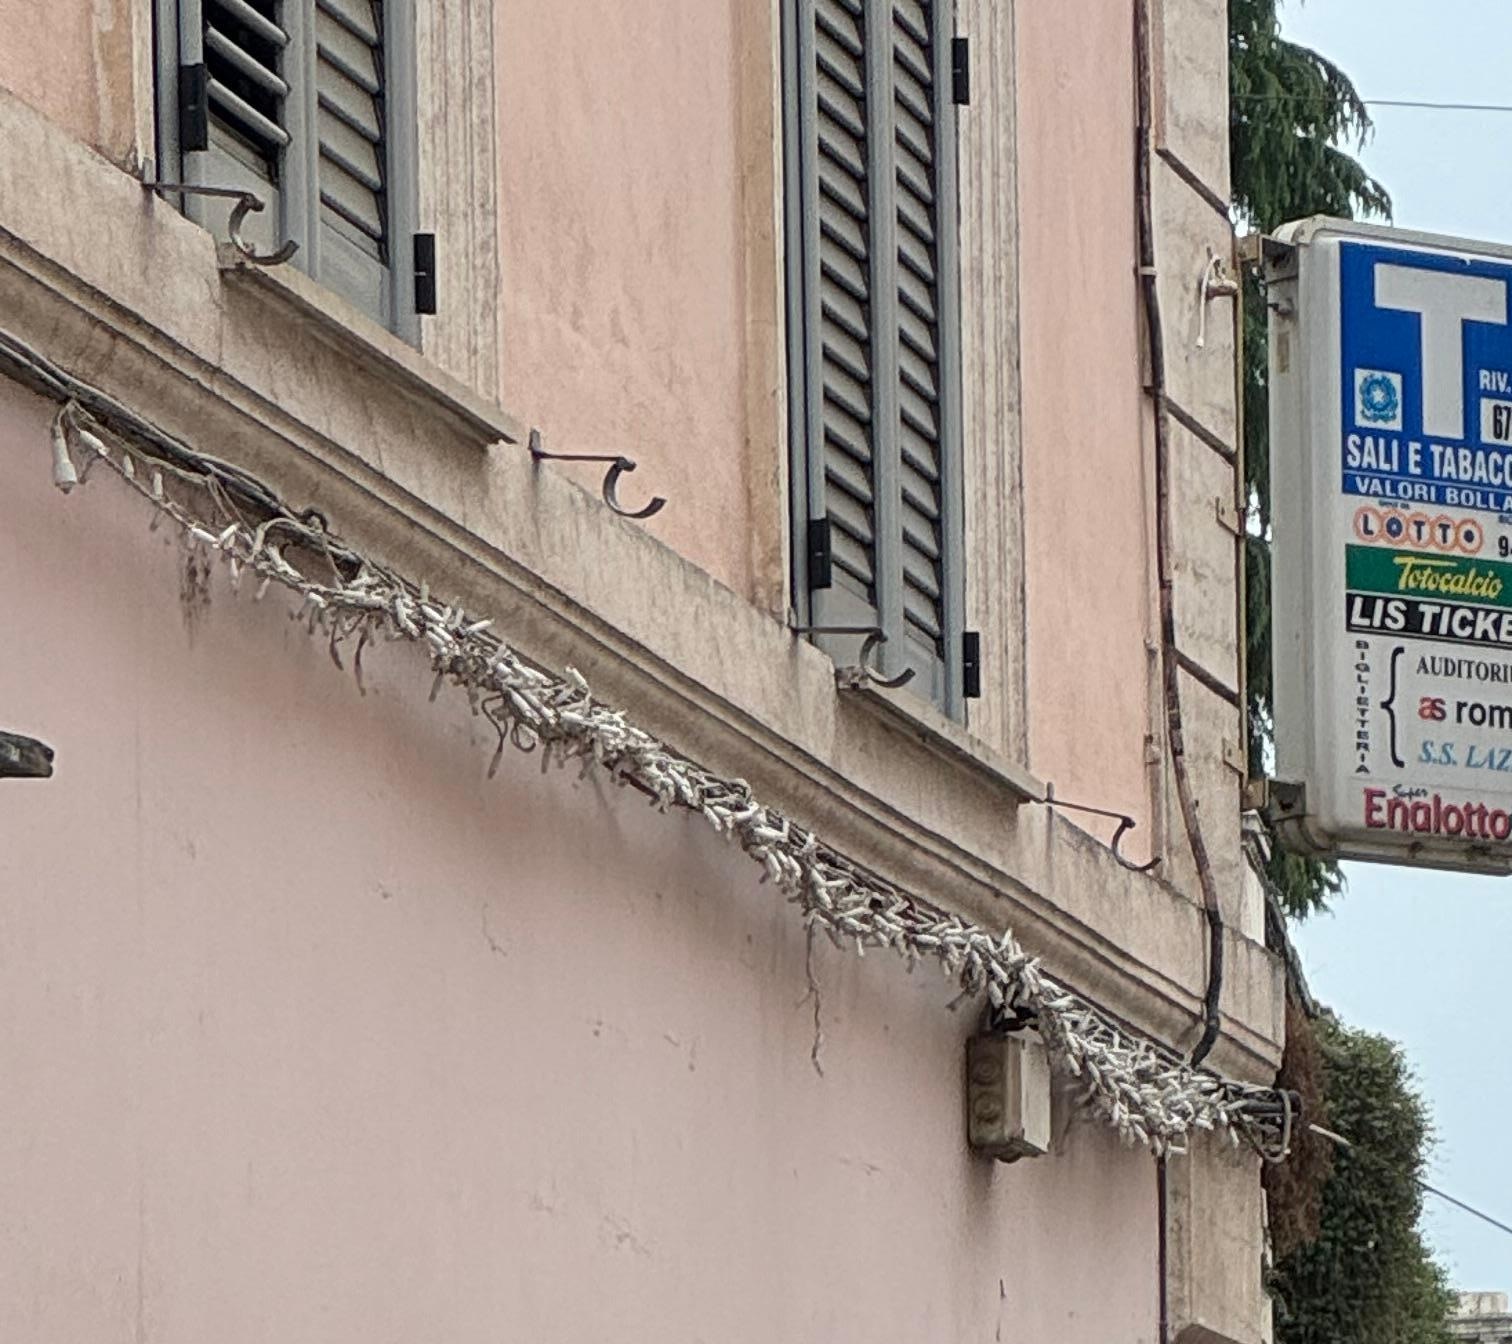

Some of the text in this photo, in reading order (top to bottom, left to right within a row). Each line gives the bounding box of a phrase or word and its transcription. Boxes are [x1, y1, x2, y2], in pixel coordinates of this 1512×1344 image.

[1374, 262, 1507, 439] T
[1479, 369, 1512, 394] RIV.
[1347, 433, 1399, 473] SALI
[1408, 440, 1422, 476] E
[1355, 476, 1436, 501] VALORI
[1359, 510, 1478, 547] LOTTO
[1393, 556, 1503, 600] Totocalcio
[1350, 596, 1407, 631] LIS
[1355, 639, 1371, 775] BIGLIETTERIA
[1418, 740, 1458, 768] S.S.
[1362, 788, 1512, 841] Enalotto
